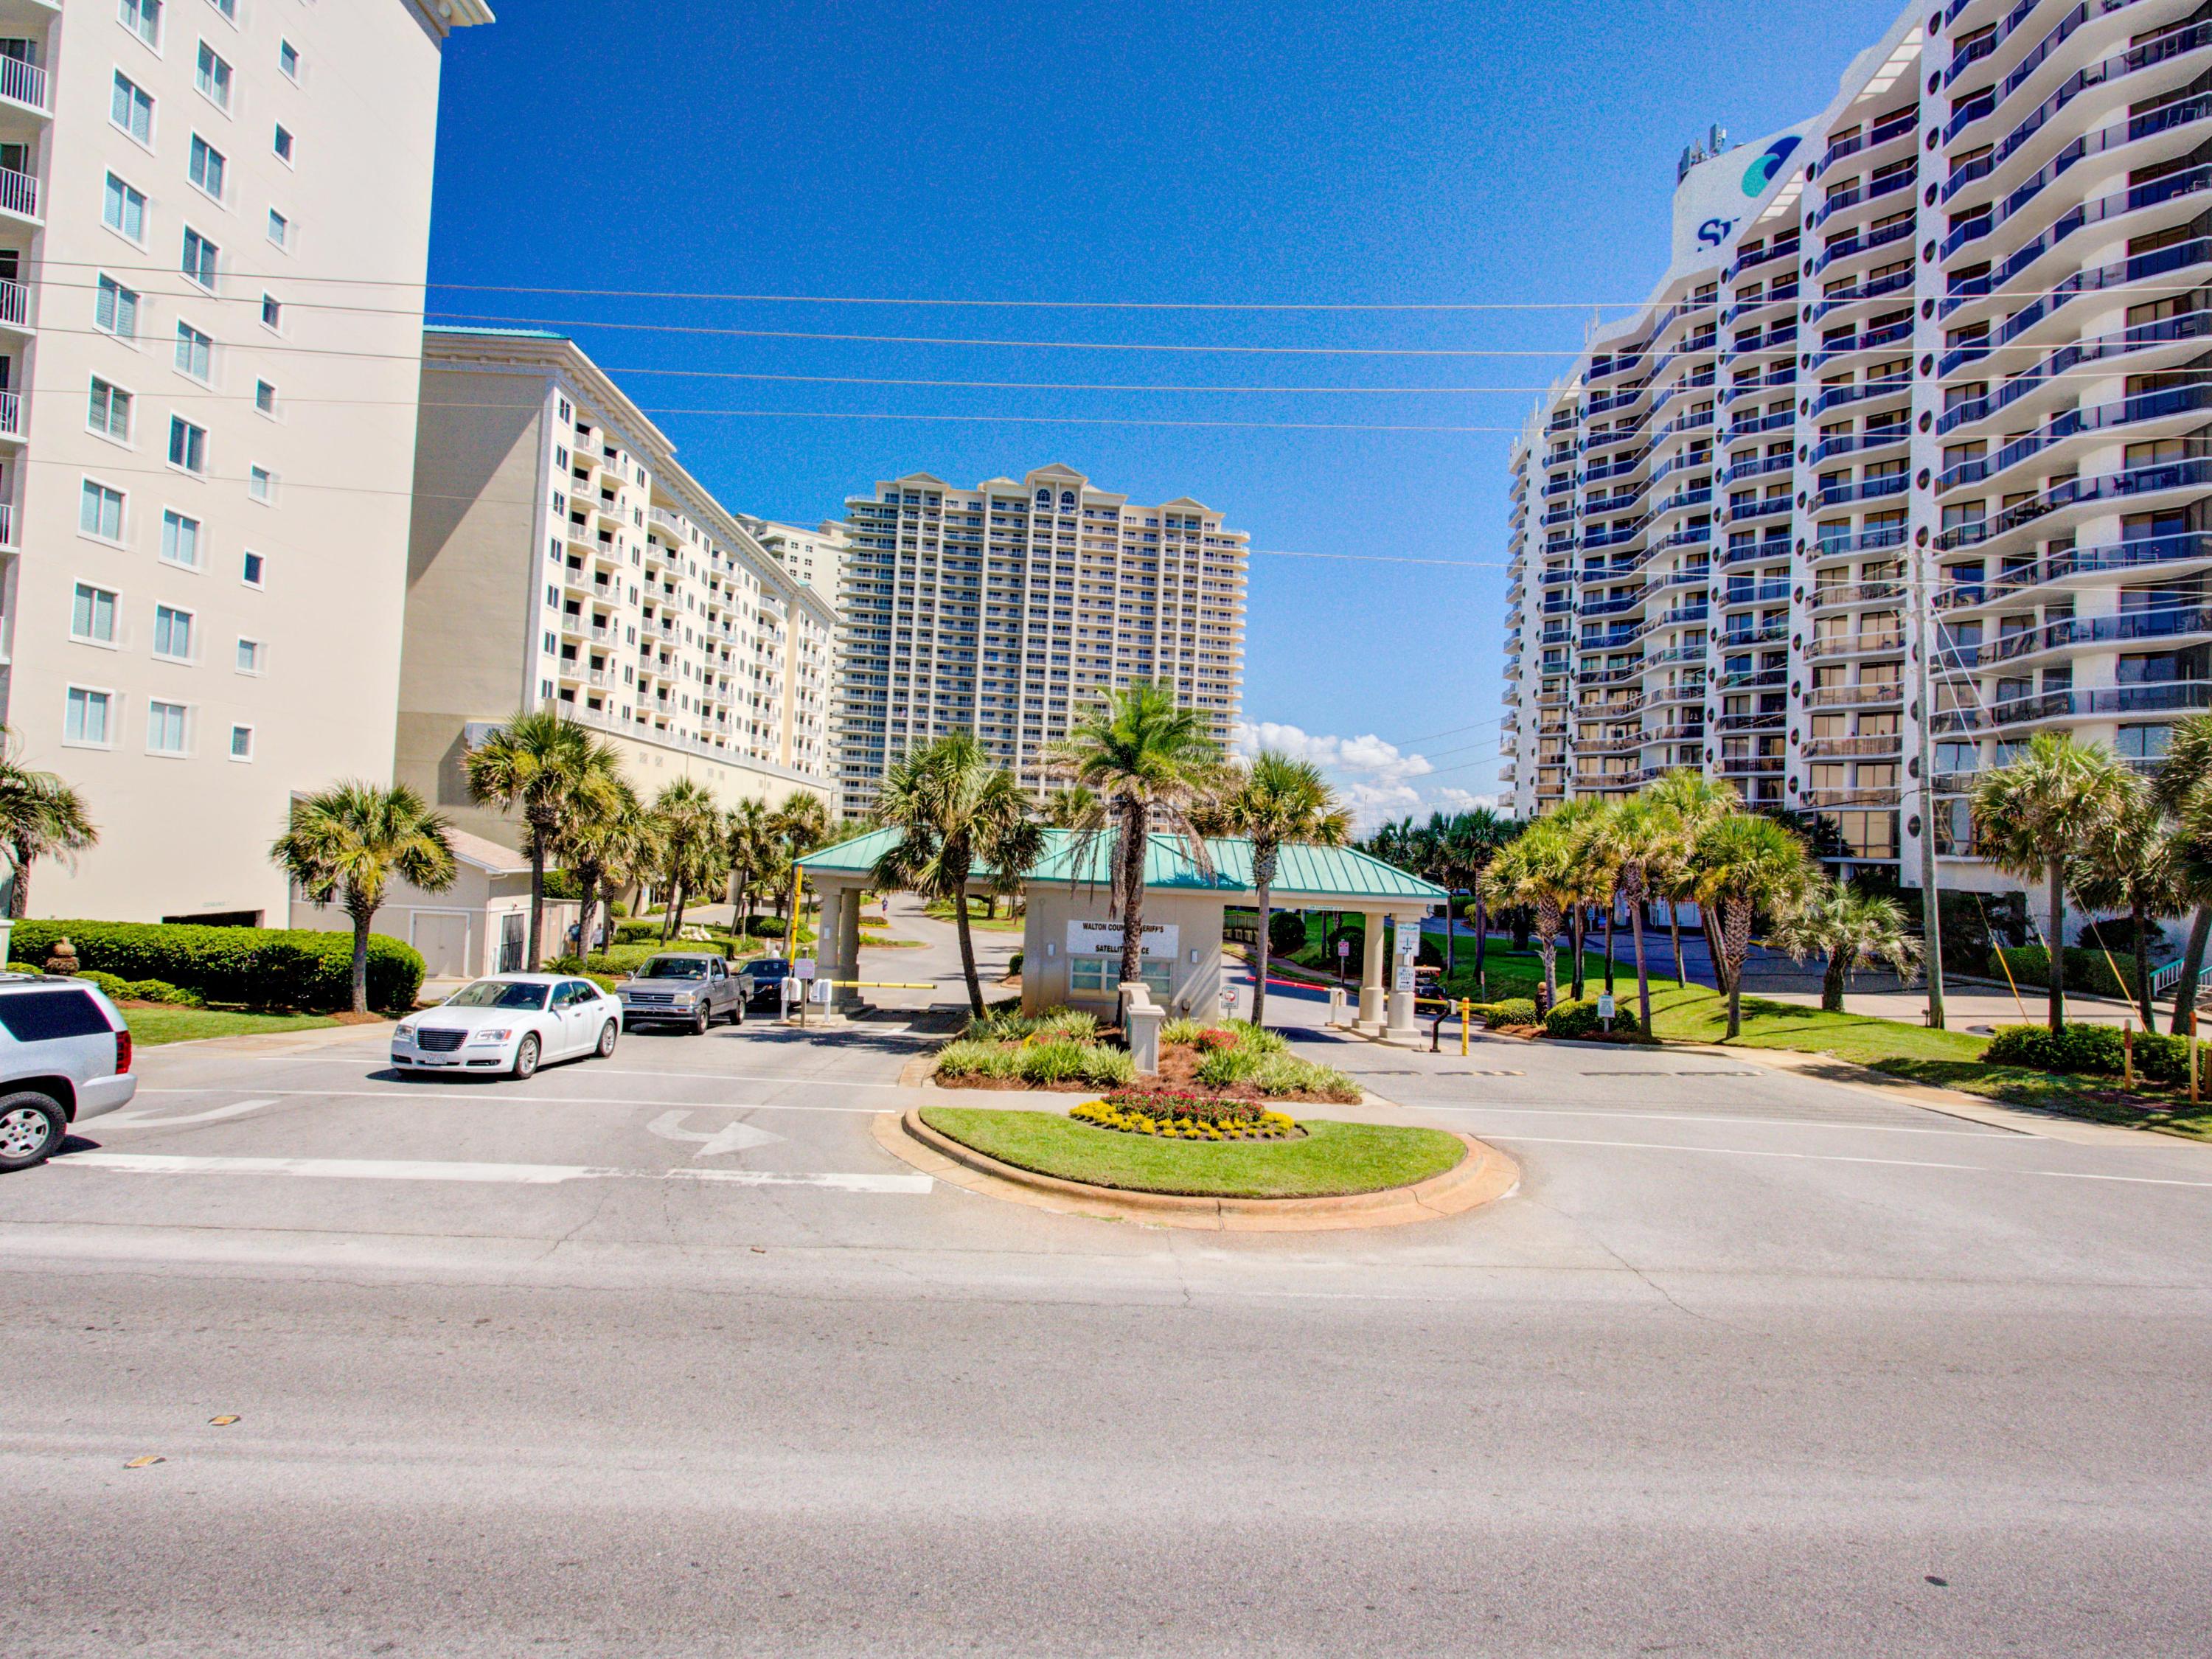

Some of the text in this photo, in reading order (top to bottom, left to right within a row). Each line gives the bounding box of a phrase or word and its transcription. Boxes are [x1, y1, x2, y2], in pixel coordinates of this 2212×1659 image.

[1082, 922, 1164, 933] WALTON COUN ERIFF'S
[1095, 945, 1124, 953] SATELLIT
